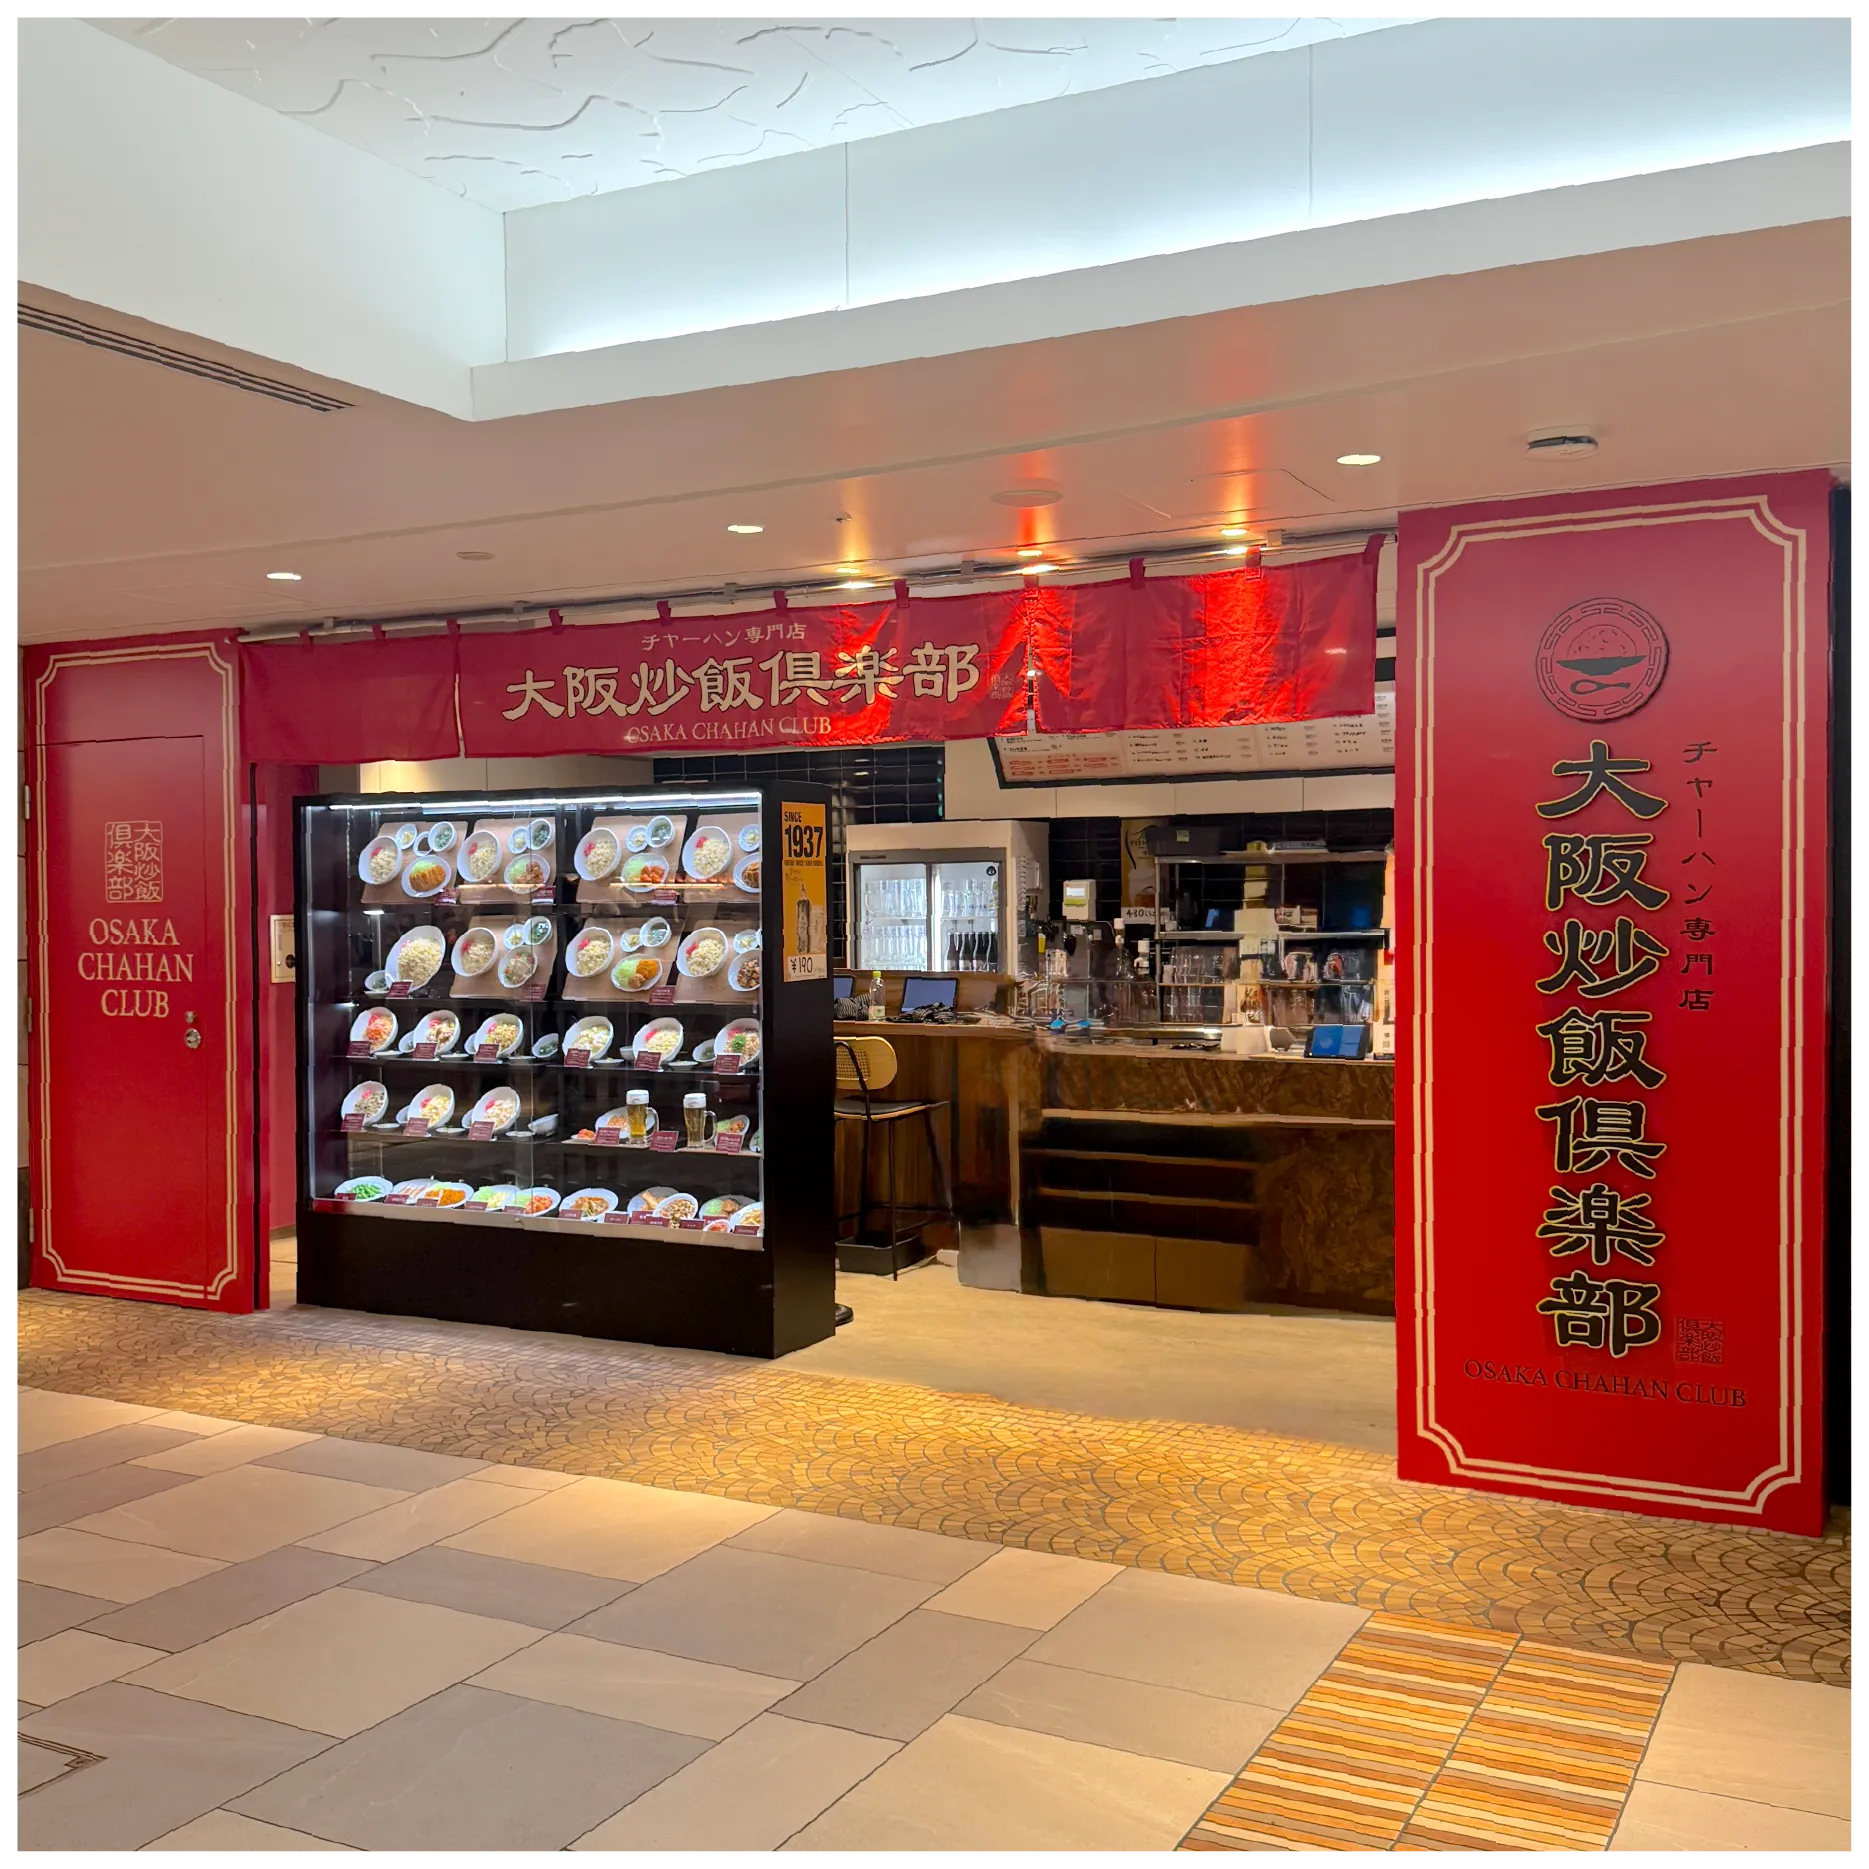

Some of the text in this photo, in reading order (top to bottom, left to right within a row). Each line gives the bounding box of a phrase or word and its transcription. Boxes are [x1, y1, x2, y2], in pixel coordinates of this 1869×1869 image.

[627, 716, 832, 744] OSAKA CHAHAN CLUB
[784, 811, 802, 823] SINCE
[785, 825, 823, 858] 1937
[89, 918, 180, 946] OSAKA
[78, 952, 194, 982] CHAHAN
[790, 957, 813, 974] ¥190
[101, 989, 169, 1018] CLUB
[1464, 1359, 1747, 1408] OSAKA CHAHAN CLUB
